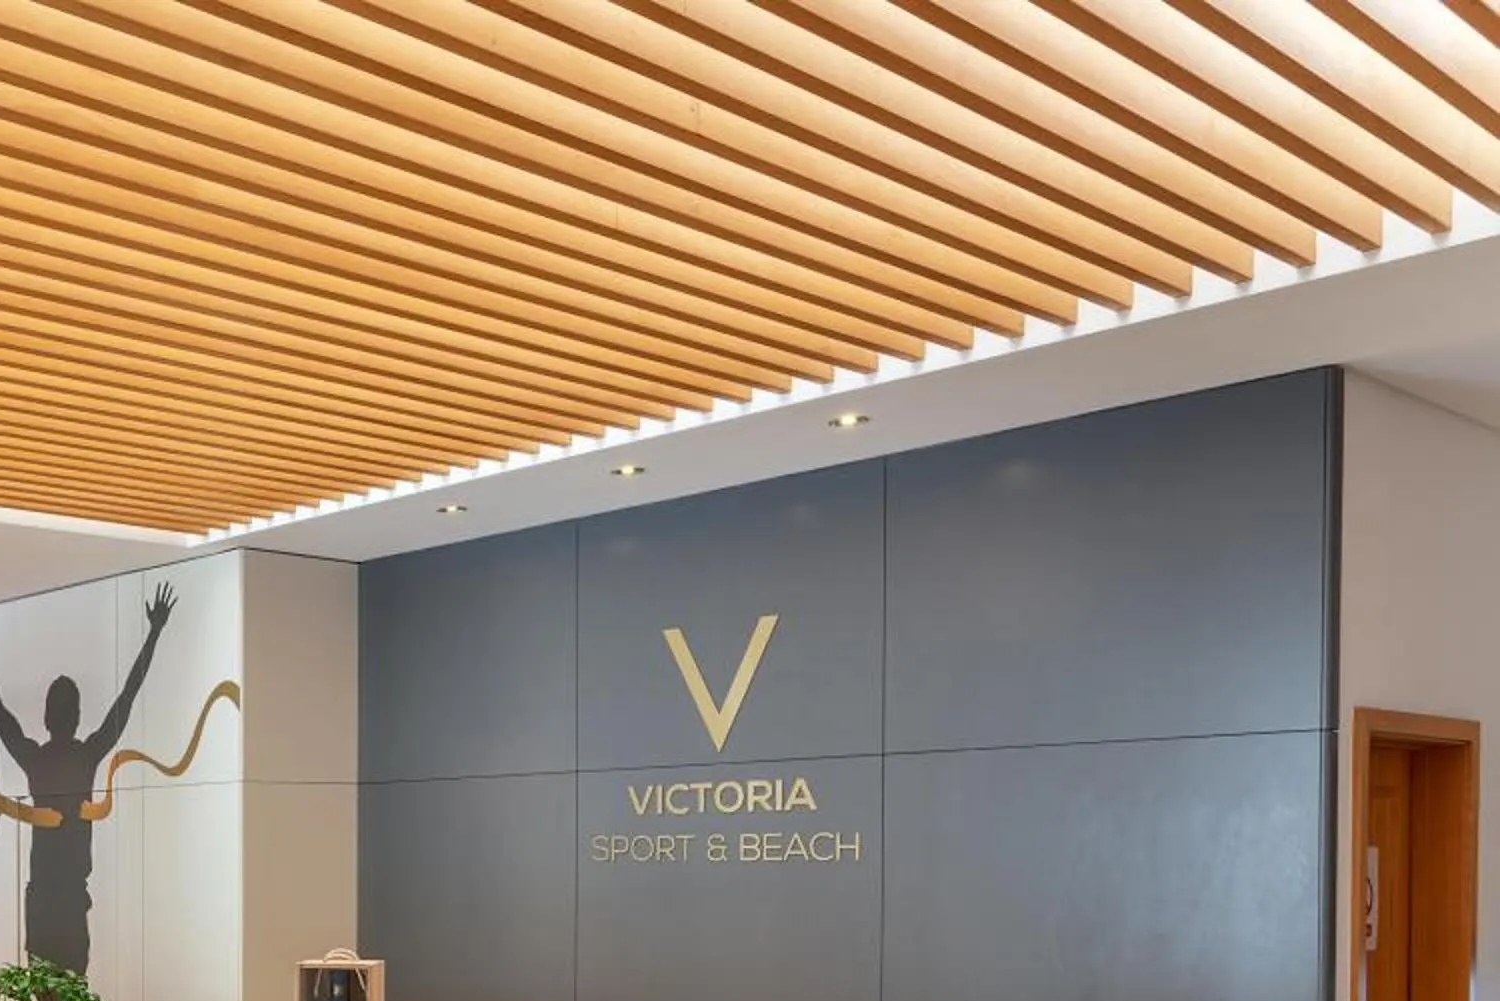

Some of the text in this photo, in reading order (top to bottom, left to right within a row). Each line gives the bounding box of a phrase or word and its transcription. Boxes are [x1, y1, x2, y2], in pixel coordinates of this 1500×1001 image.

[662, 613, 779, 753] V
[627, 777, 818, 817] VICTORIA
[590, 830, 861, 863] SPORT & BEACH
